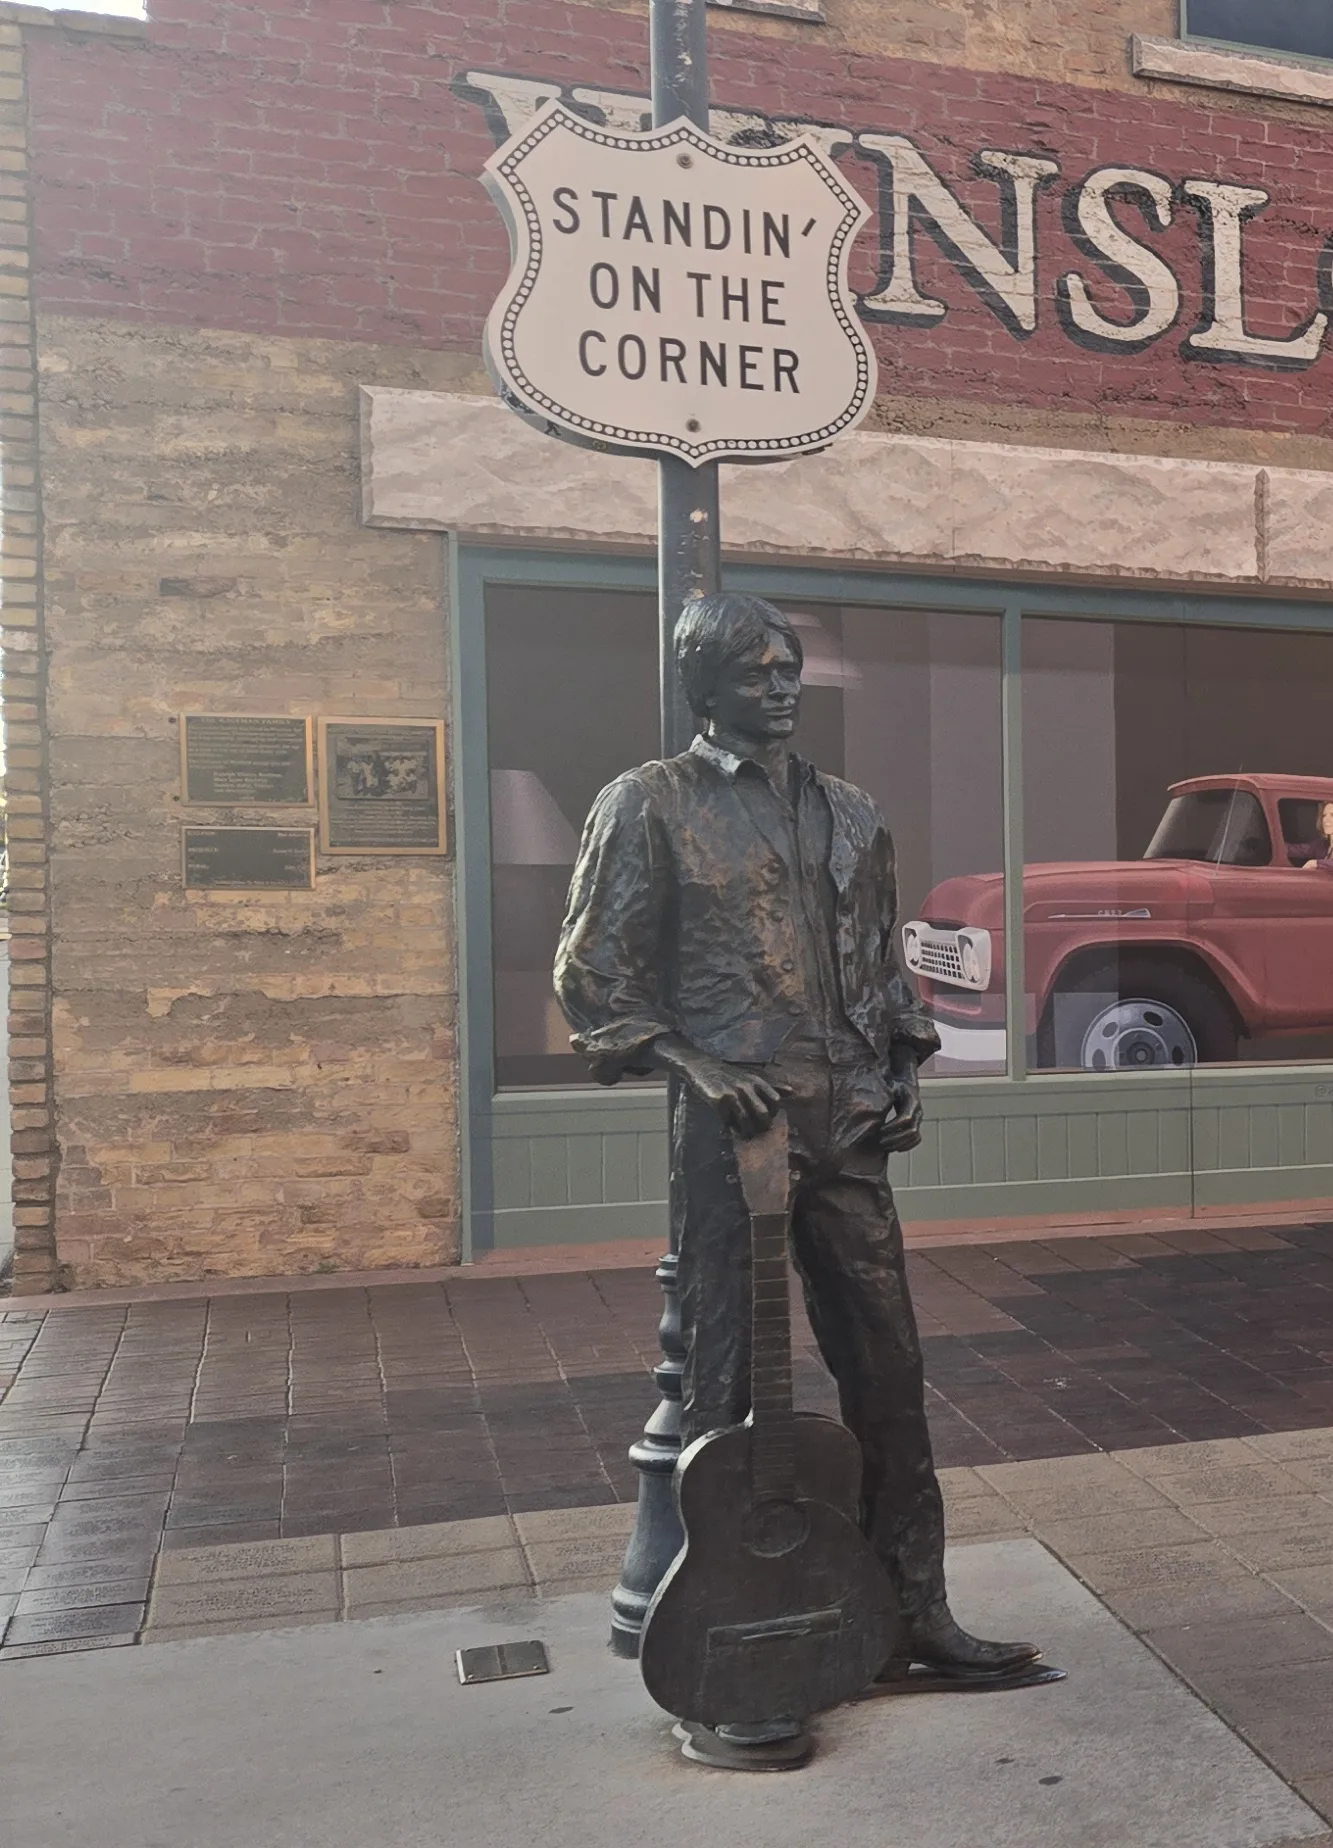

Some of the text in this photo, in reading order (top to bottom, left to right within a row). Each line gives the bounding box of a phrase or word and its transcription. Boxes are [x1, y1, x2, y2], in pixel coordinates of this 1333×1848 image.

[551, 186, 816, 259] STANDIN'
[589, 261, 787, 326] ON THE
[578, 329, 801, 395] CORNER
